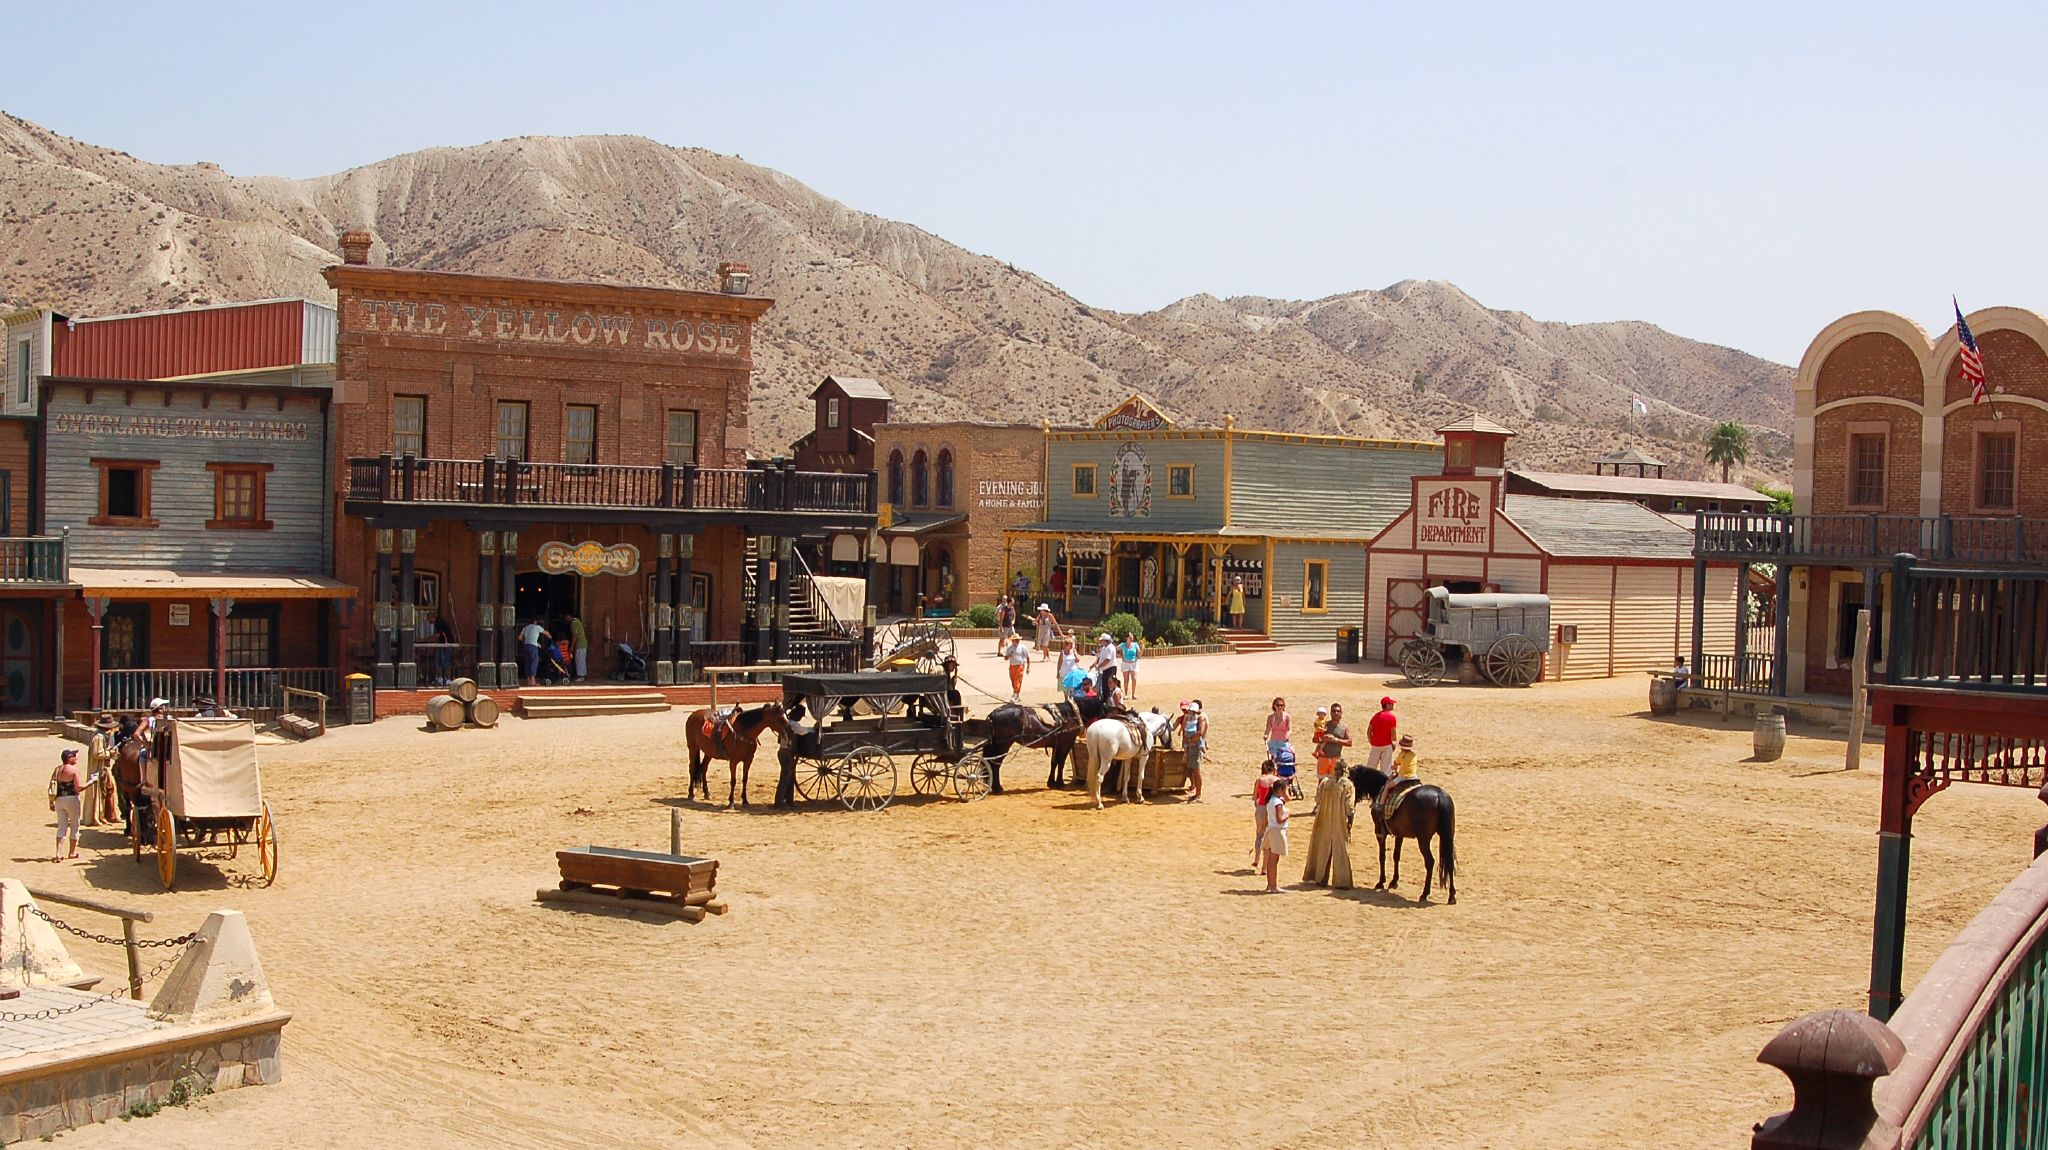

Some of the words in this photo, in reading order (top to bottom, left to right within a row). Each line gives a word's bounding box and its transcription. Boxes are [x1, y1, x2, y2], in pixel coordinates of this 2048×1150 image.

[359, 299, 447, 335] THE
[462, 306, 634, 346] YELLOW
[643, 318, 741, 355] ROSE
[55, 413, 170, 438] OVERLAND
[174, 417, 241, 440] STAGE
[247, 418, 308, 442] LINES
[979, 481, 1025, 495] EVENING
[978, 500, 985, 508] A
[985, 499, 1008, 508] HOME
[1009, 500, 1015, 508] &
[1427, 487, 1481, 526] FIRE
[1420, 525, 1487, 546] DEPARTMENT
[547, 547, 630, 569] SALOON
